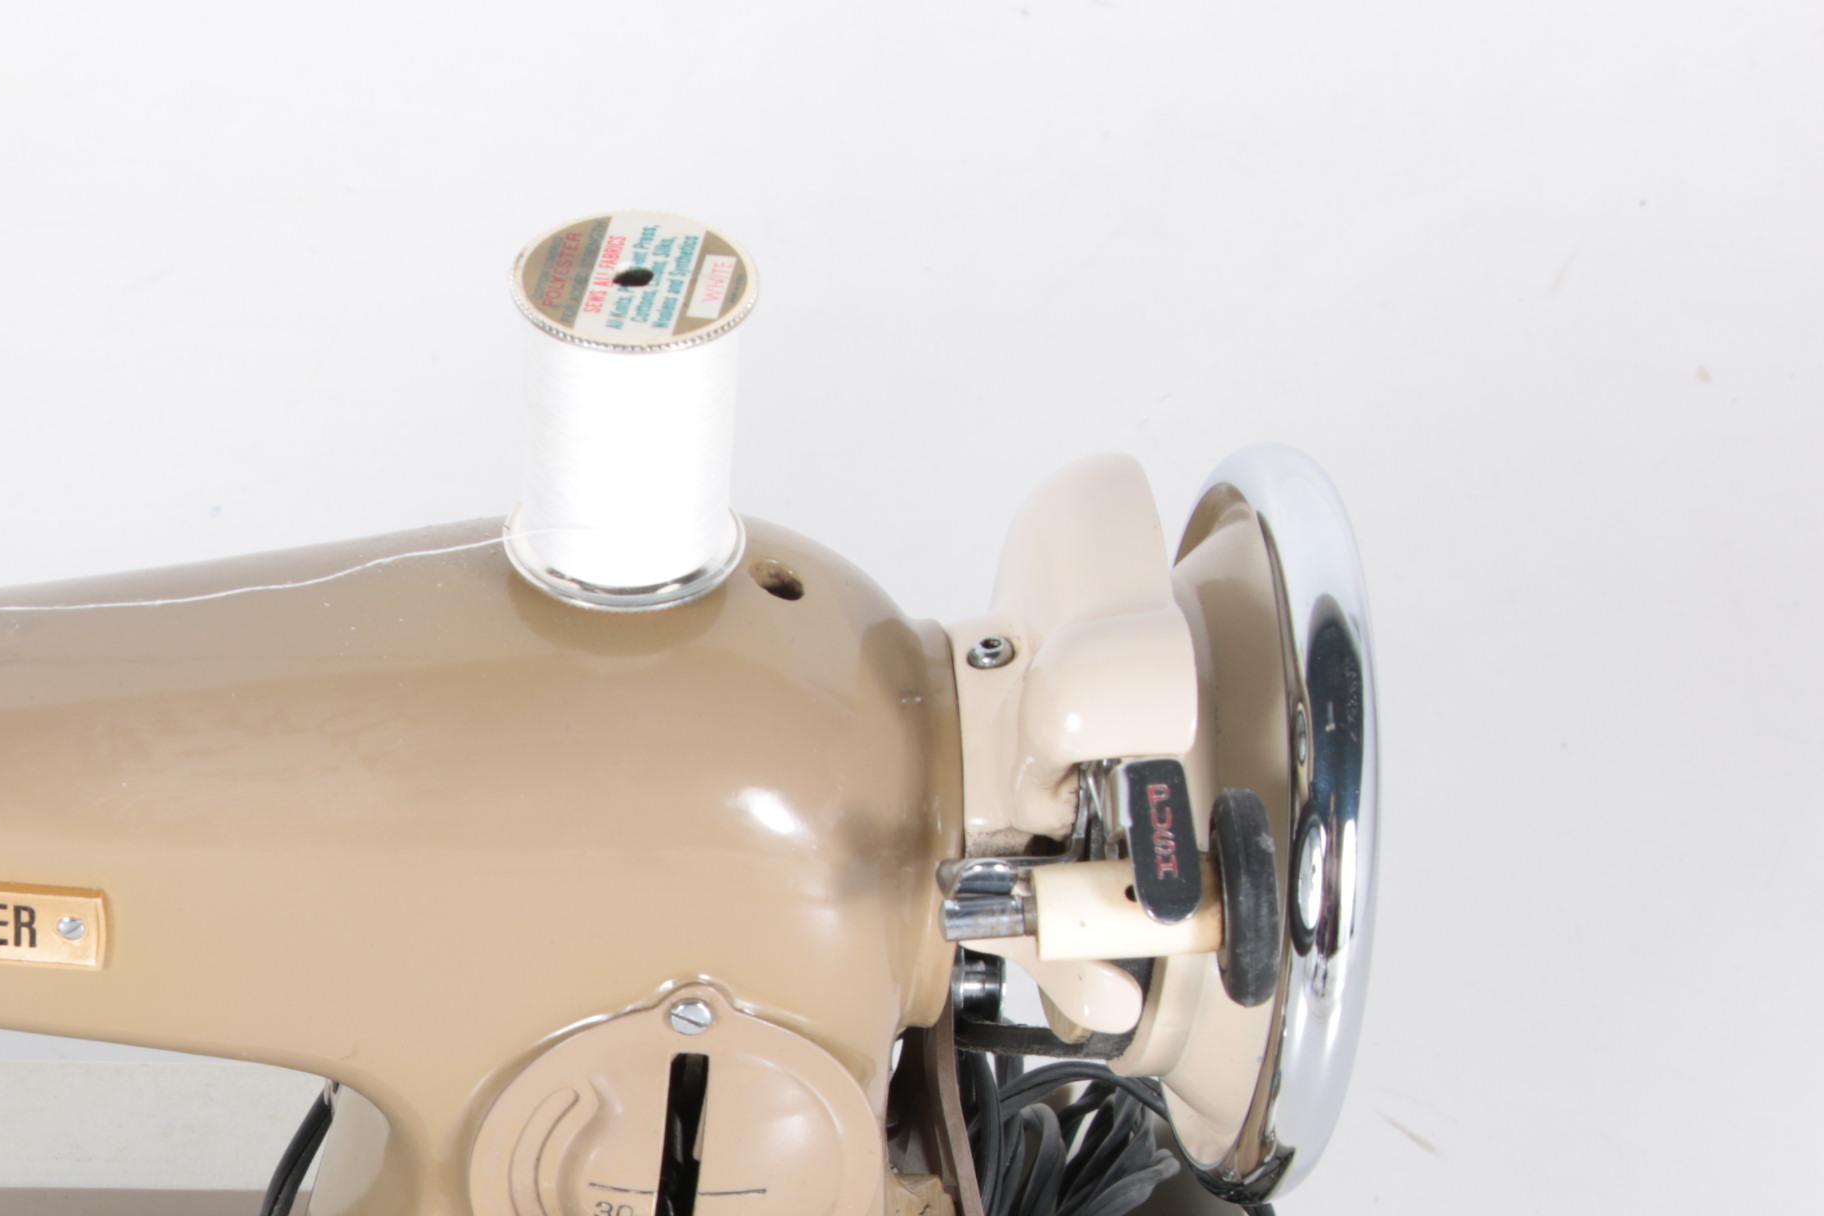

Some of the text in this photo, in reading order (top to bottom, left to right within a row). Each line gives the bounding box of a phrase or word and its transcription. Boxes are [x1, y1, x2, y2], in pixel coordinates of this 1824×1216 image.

[542, 231, 582, 309] POLYESTER
[584, 290, 608, 314] SEWS
[598, 235, 626, 268] FABRICS
[703, 262, 735, 304] WHITE
[1147, 783, 1179, 880] PUSH
